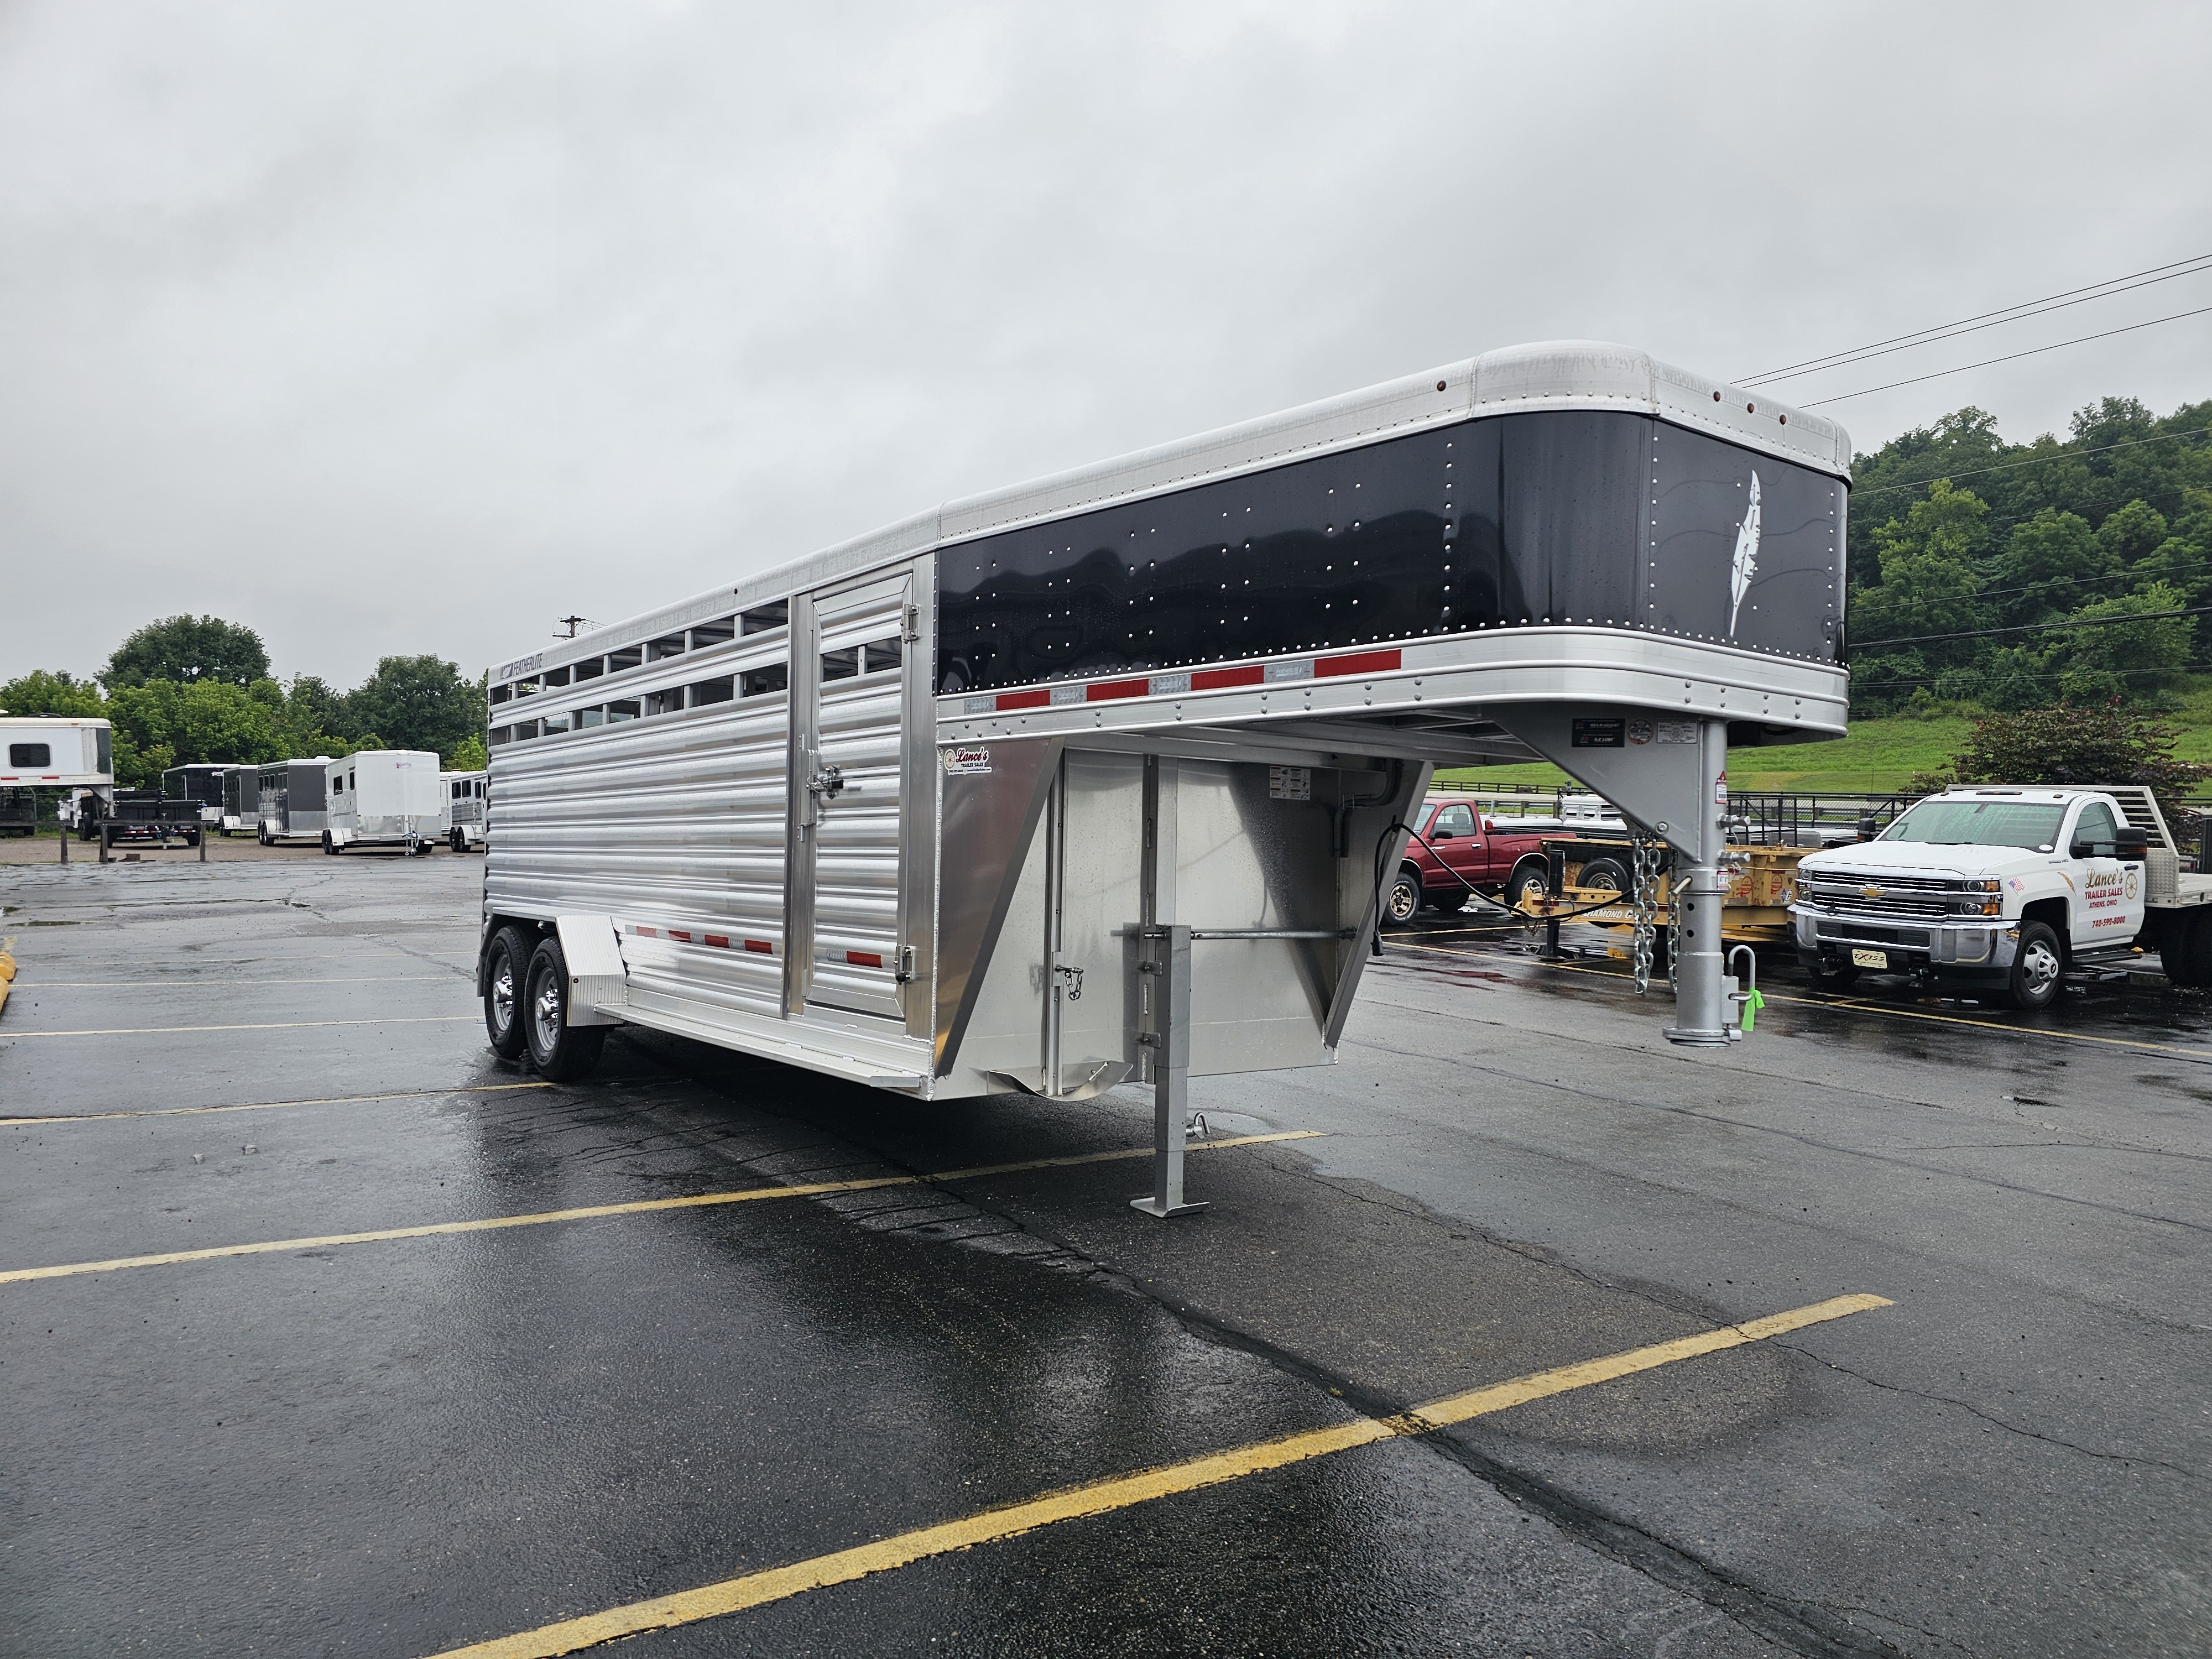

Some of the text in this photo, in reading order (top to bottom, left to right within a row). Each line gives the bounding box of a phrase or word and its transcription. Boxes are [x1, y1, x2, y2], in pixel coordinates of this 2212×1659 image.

[513, 653, 543, 676] FEATHERLITE
[956, 748, 988, 763] Lance's
[2085, 868, 2124, 889] Lance's
[2085, 888, 2123, 900] TRAILER SALES
[2089, 900, 2106, 909] ATHENS,
[1624, 909, 1634, 920] C
[2092, 916, 2126, 928] 740-592-8000
